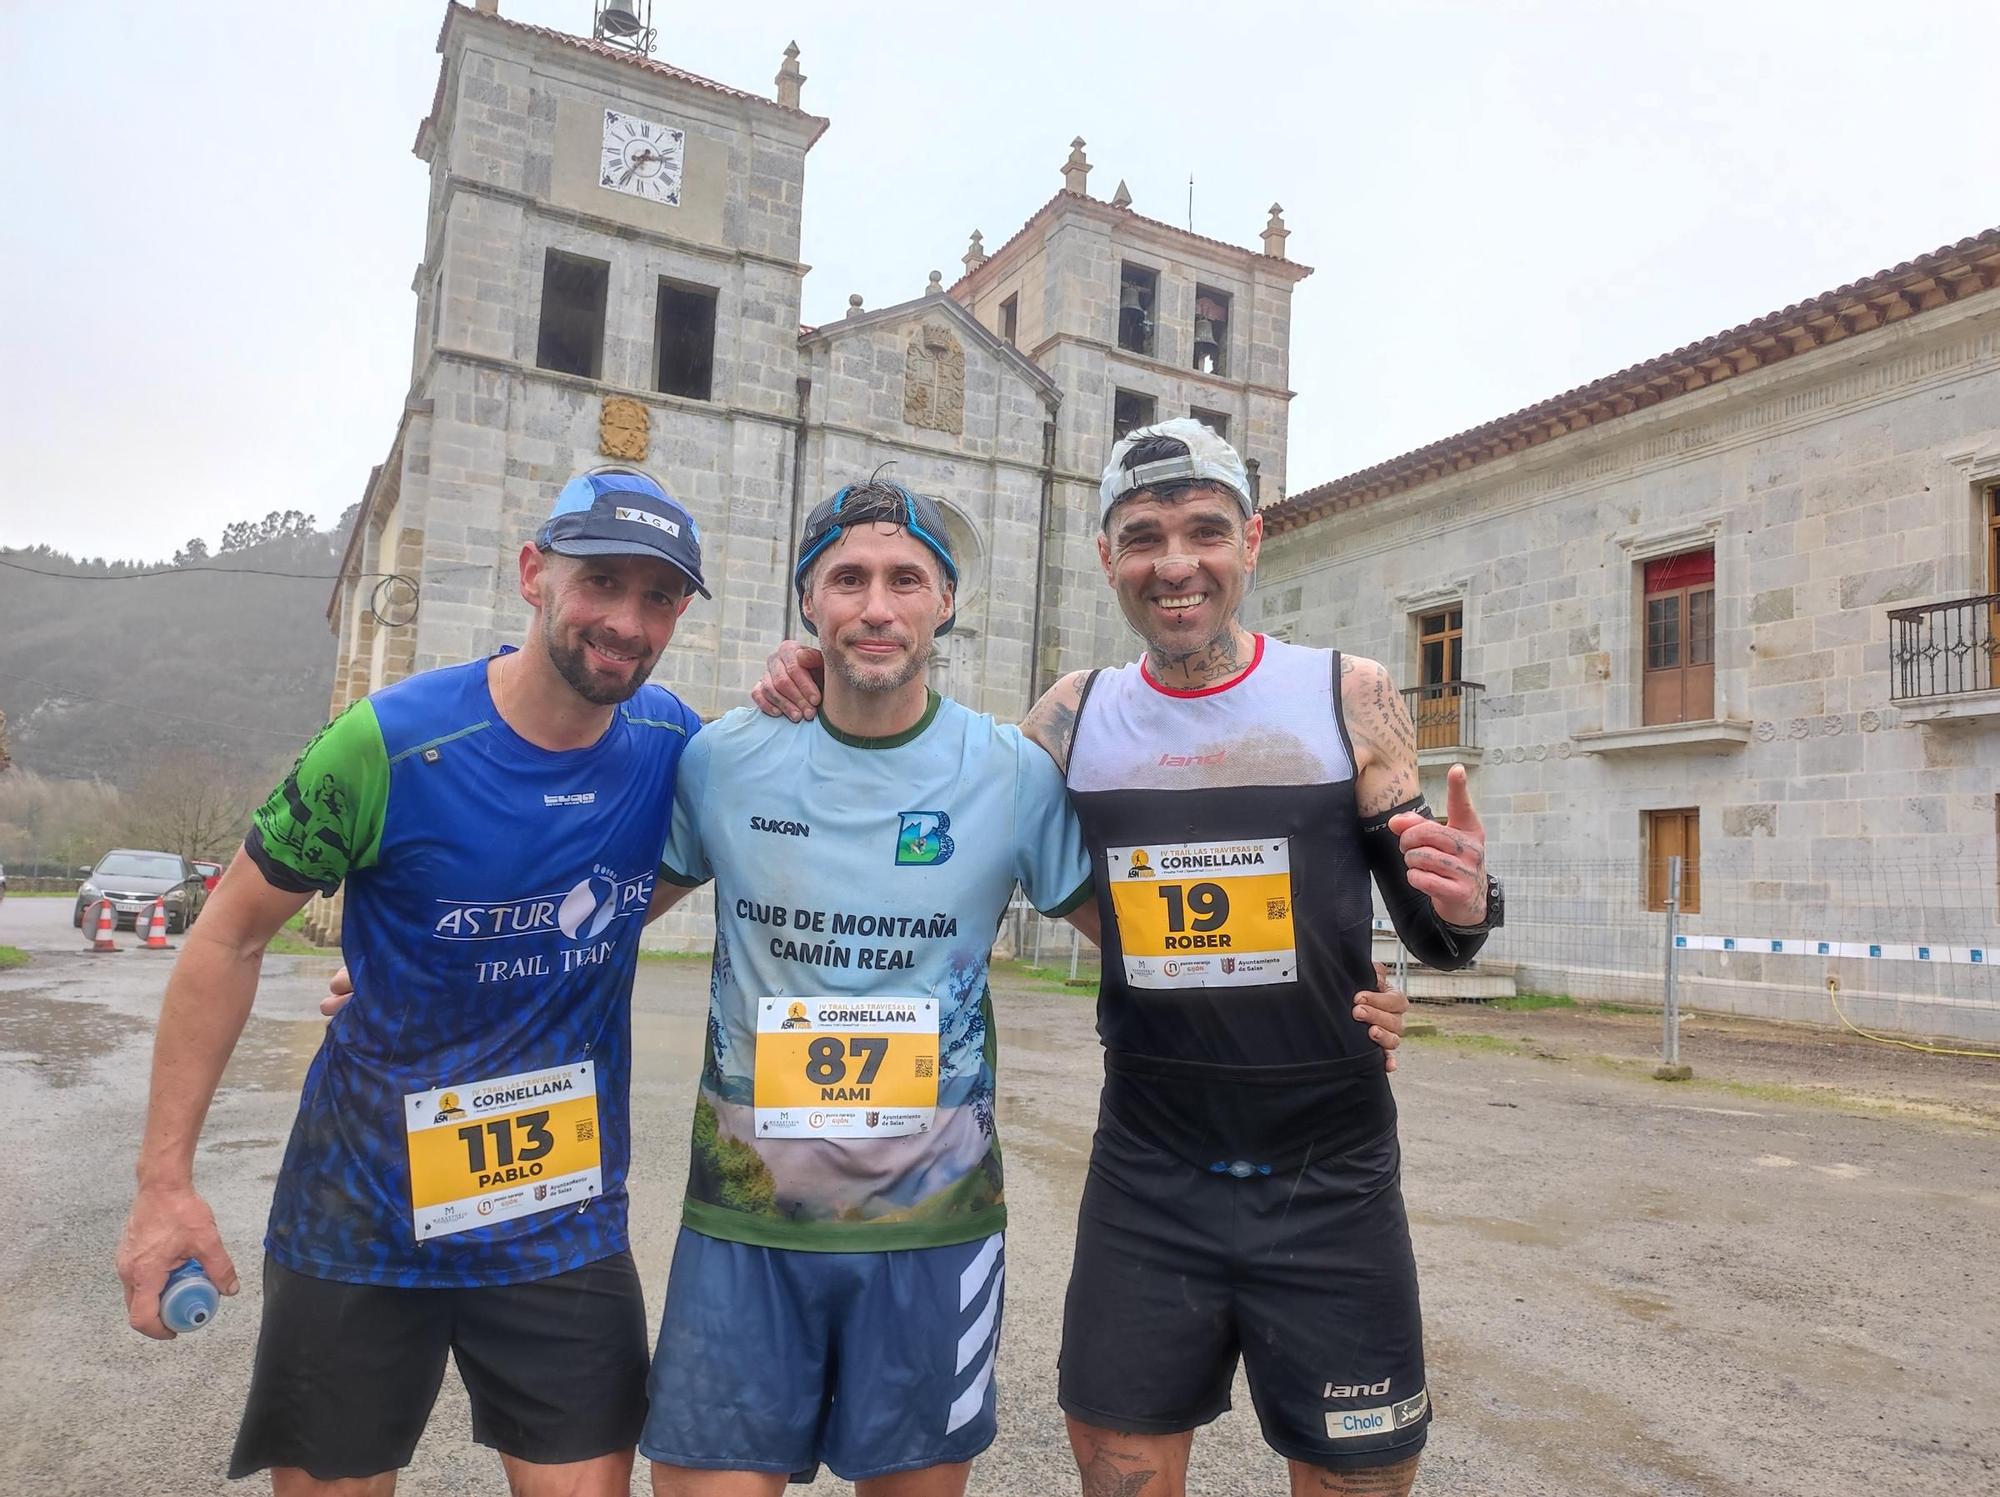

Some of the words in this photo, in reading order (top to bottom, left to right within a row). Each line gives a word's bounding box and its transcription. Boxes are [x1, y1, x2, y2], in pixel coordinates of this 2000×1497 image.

[1158, 751, 1226, 767] land
[750, 816, 810, 838] SUKAN
[1161, 852, 1264, 869] CORNELLANA
[1210, 846, 1251, 854] TRAVIESAS
[435, 901, 555, 935] ASTUR
[735, 898, 787, 927] CLUB
[793, 909, 826, 933] DE
[831, 912, 958, 938] MONTAÑA
[1158, 882, 1229, 932] 19
[1165, 934, 1232, 949] ROBER
[769, 938, 851, 969] CAMÍN
[857, 948, 915, 970] REAL
[1238, 958, 1280, 966] Ayuntamiento
[475, 954, 549, 984] TRAIL
[818, 1010, 916, 1022] CORNELLANA
[806, 1037, 889, 1085] 87
[473, 1079, 573, 1108] CORNELLANA
[821, 1088, 870, 1101] NAMI
[458, 1110, 555, 1174] 113
[479, 1163, 543, 1188] PABLO
[1323, 1377, 1391, 1398] land
[1343, 1414, 1383, 1431] Cholo
